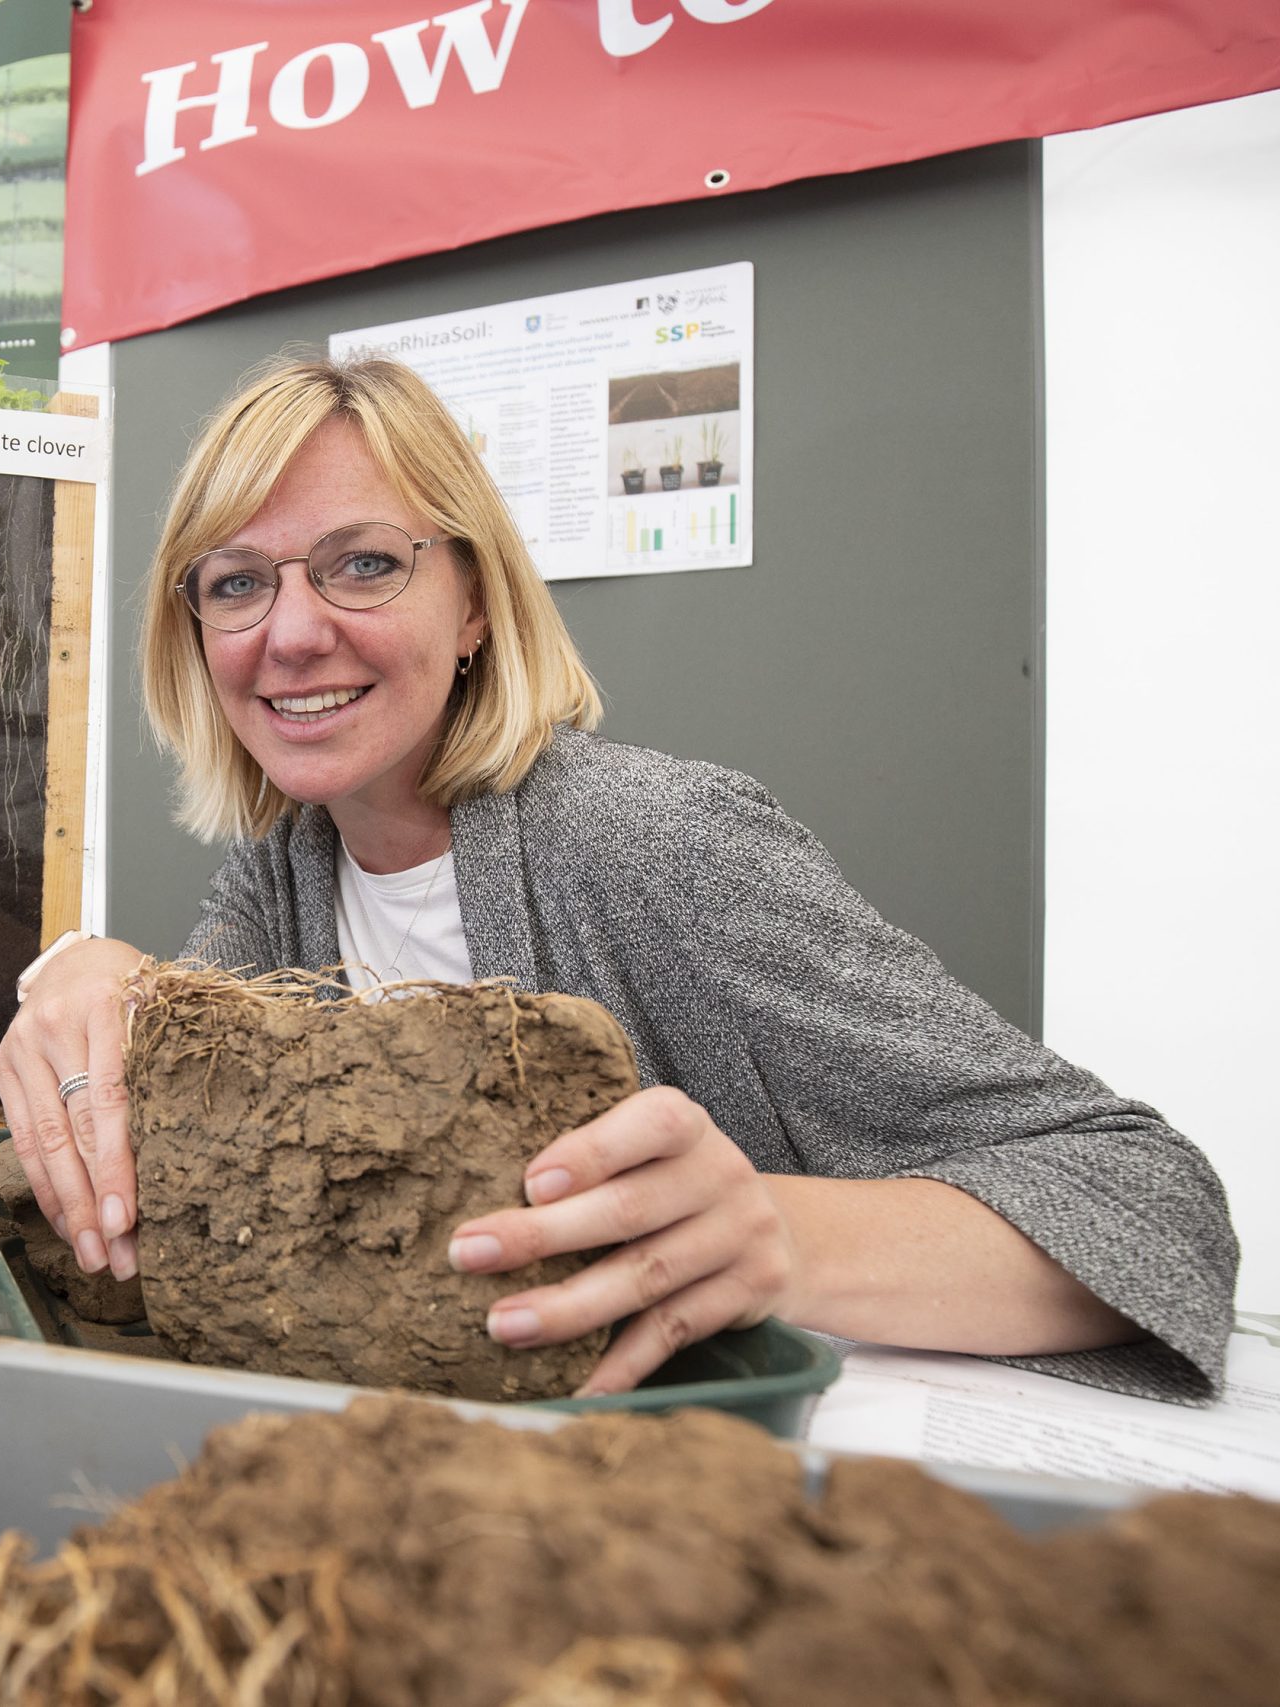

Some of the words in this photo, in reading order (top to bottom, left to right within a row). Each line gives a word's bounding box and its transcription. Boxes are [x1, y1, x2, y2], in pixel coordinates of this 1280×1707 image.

[134, 0, 526, 177] How
[655, 322, 700, 345] SSP
[27, 435, 86, 459] clover
